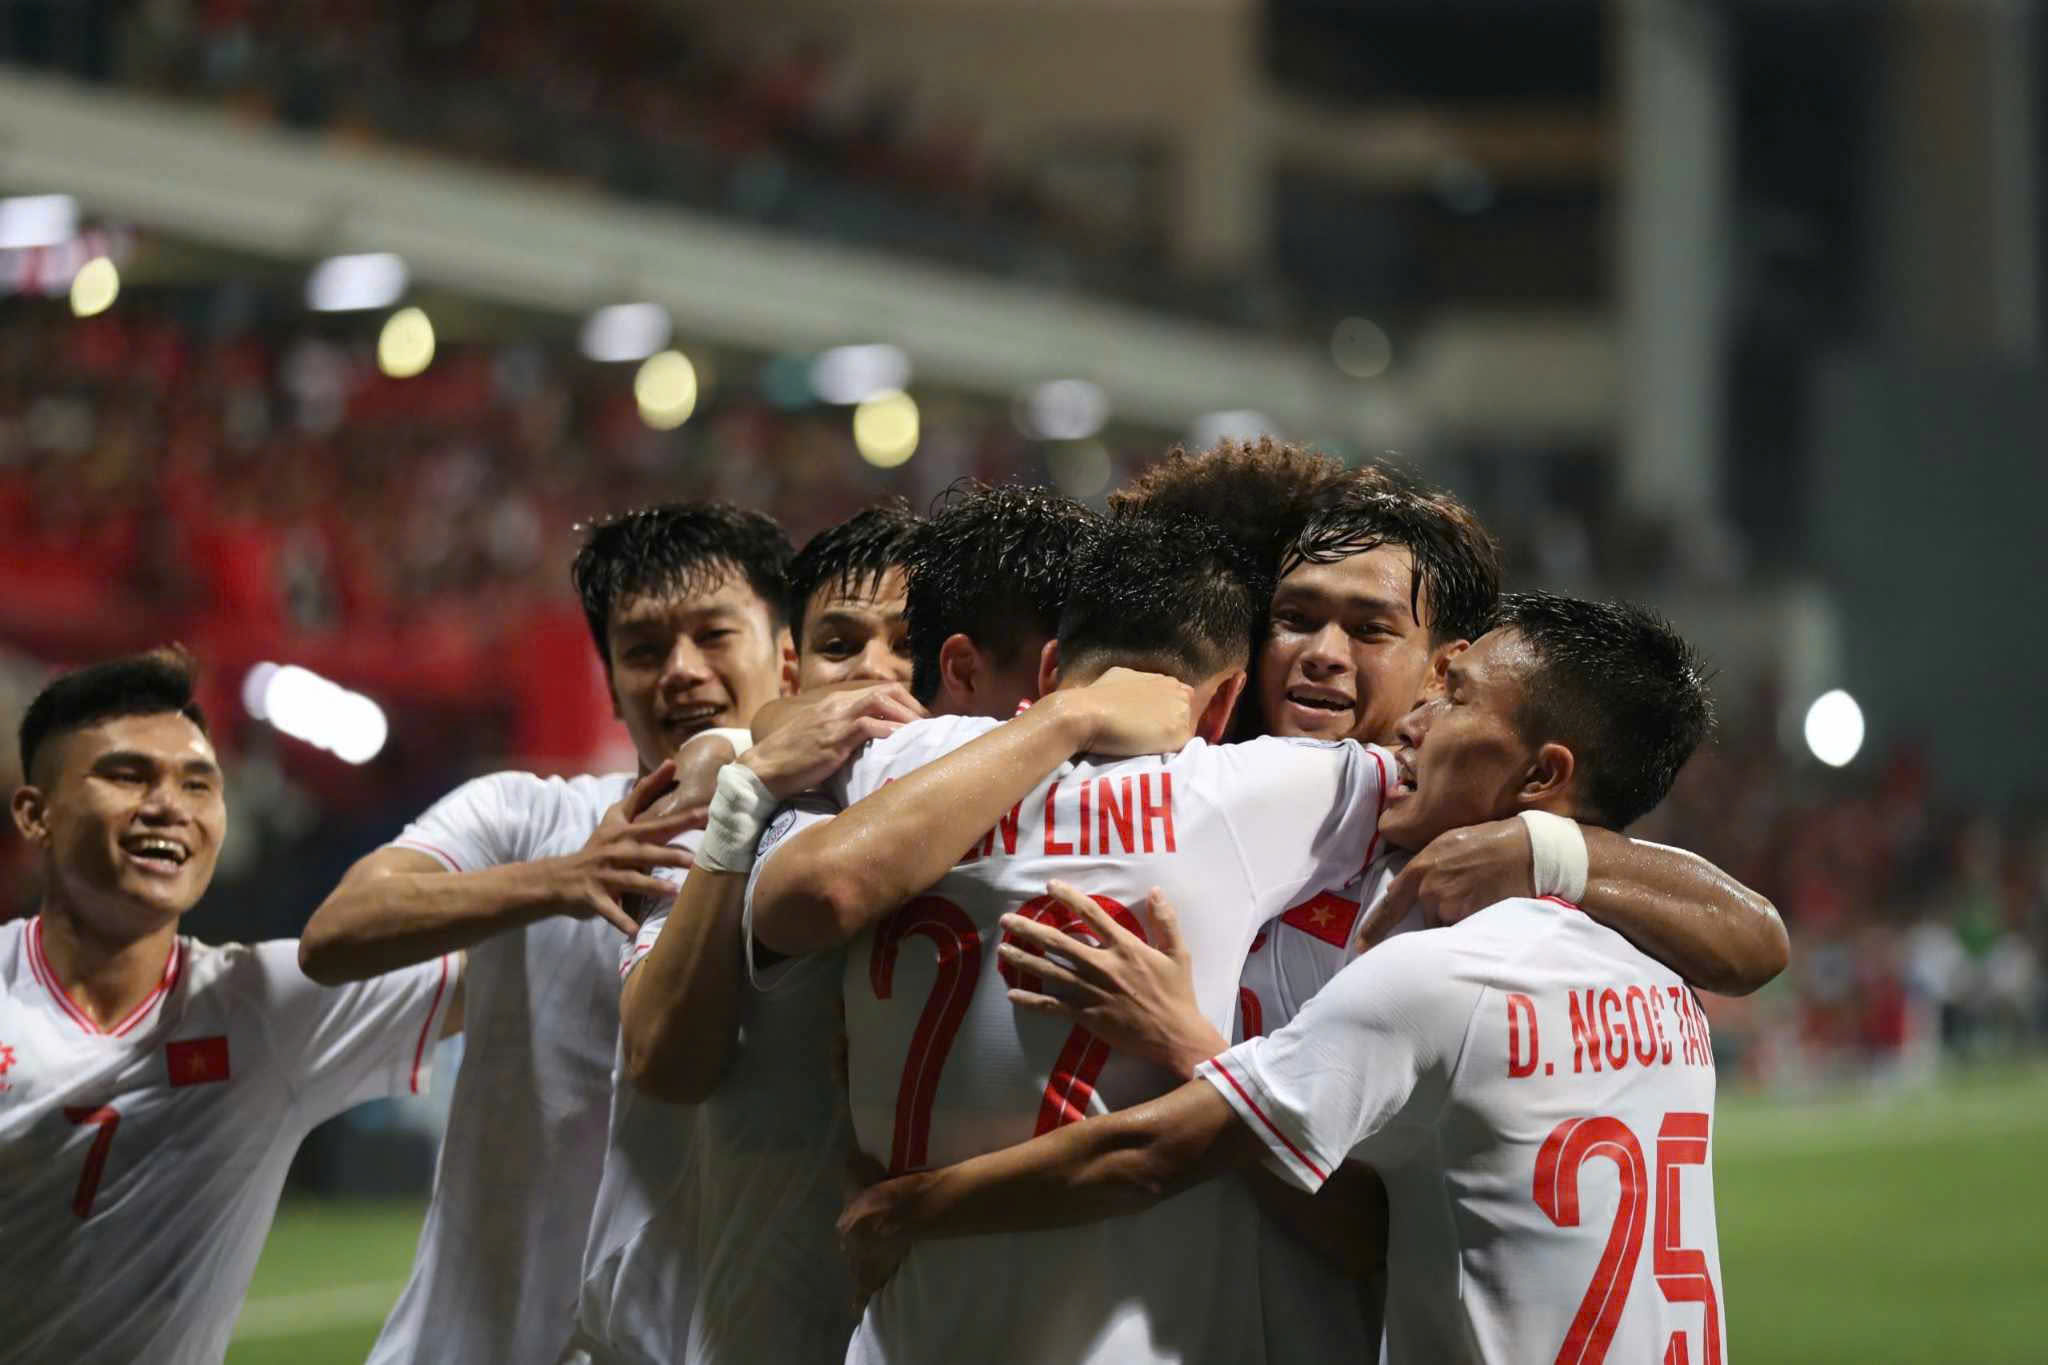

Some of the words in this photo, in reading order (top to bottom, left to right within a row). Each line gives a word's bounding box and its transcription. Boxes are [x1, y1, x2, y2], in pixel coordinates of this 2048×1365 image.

[1044, 772, 1176, 856] LINH
[1507, 993, 1554, 1078] D.
[1568, 984, 1672, 1073] NGOC
[63, 1104, 121, 1218] 7
[1533, 1112, 1721, 1365] 25
